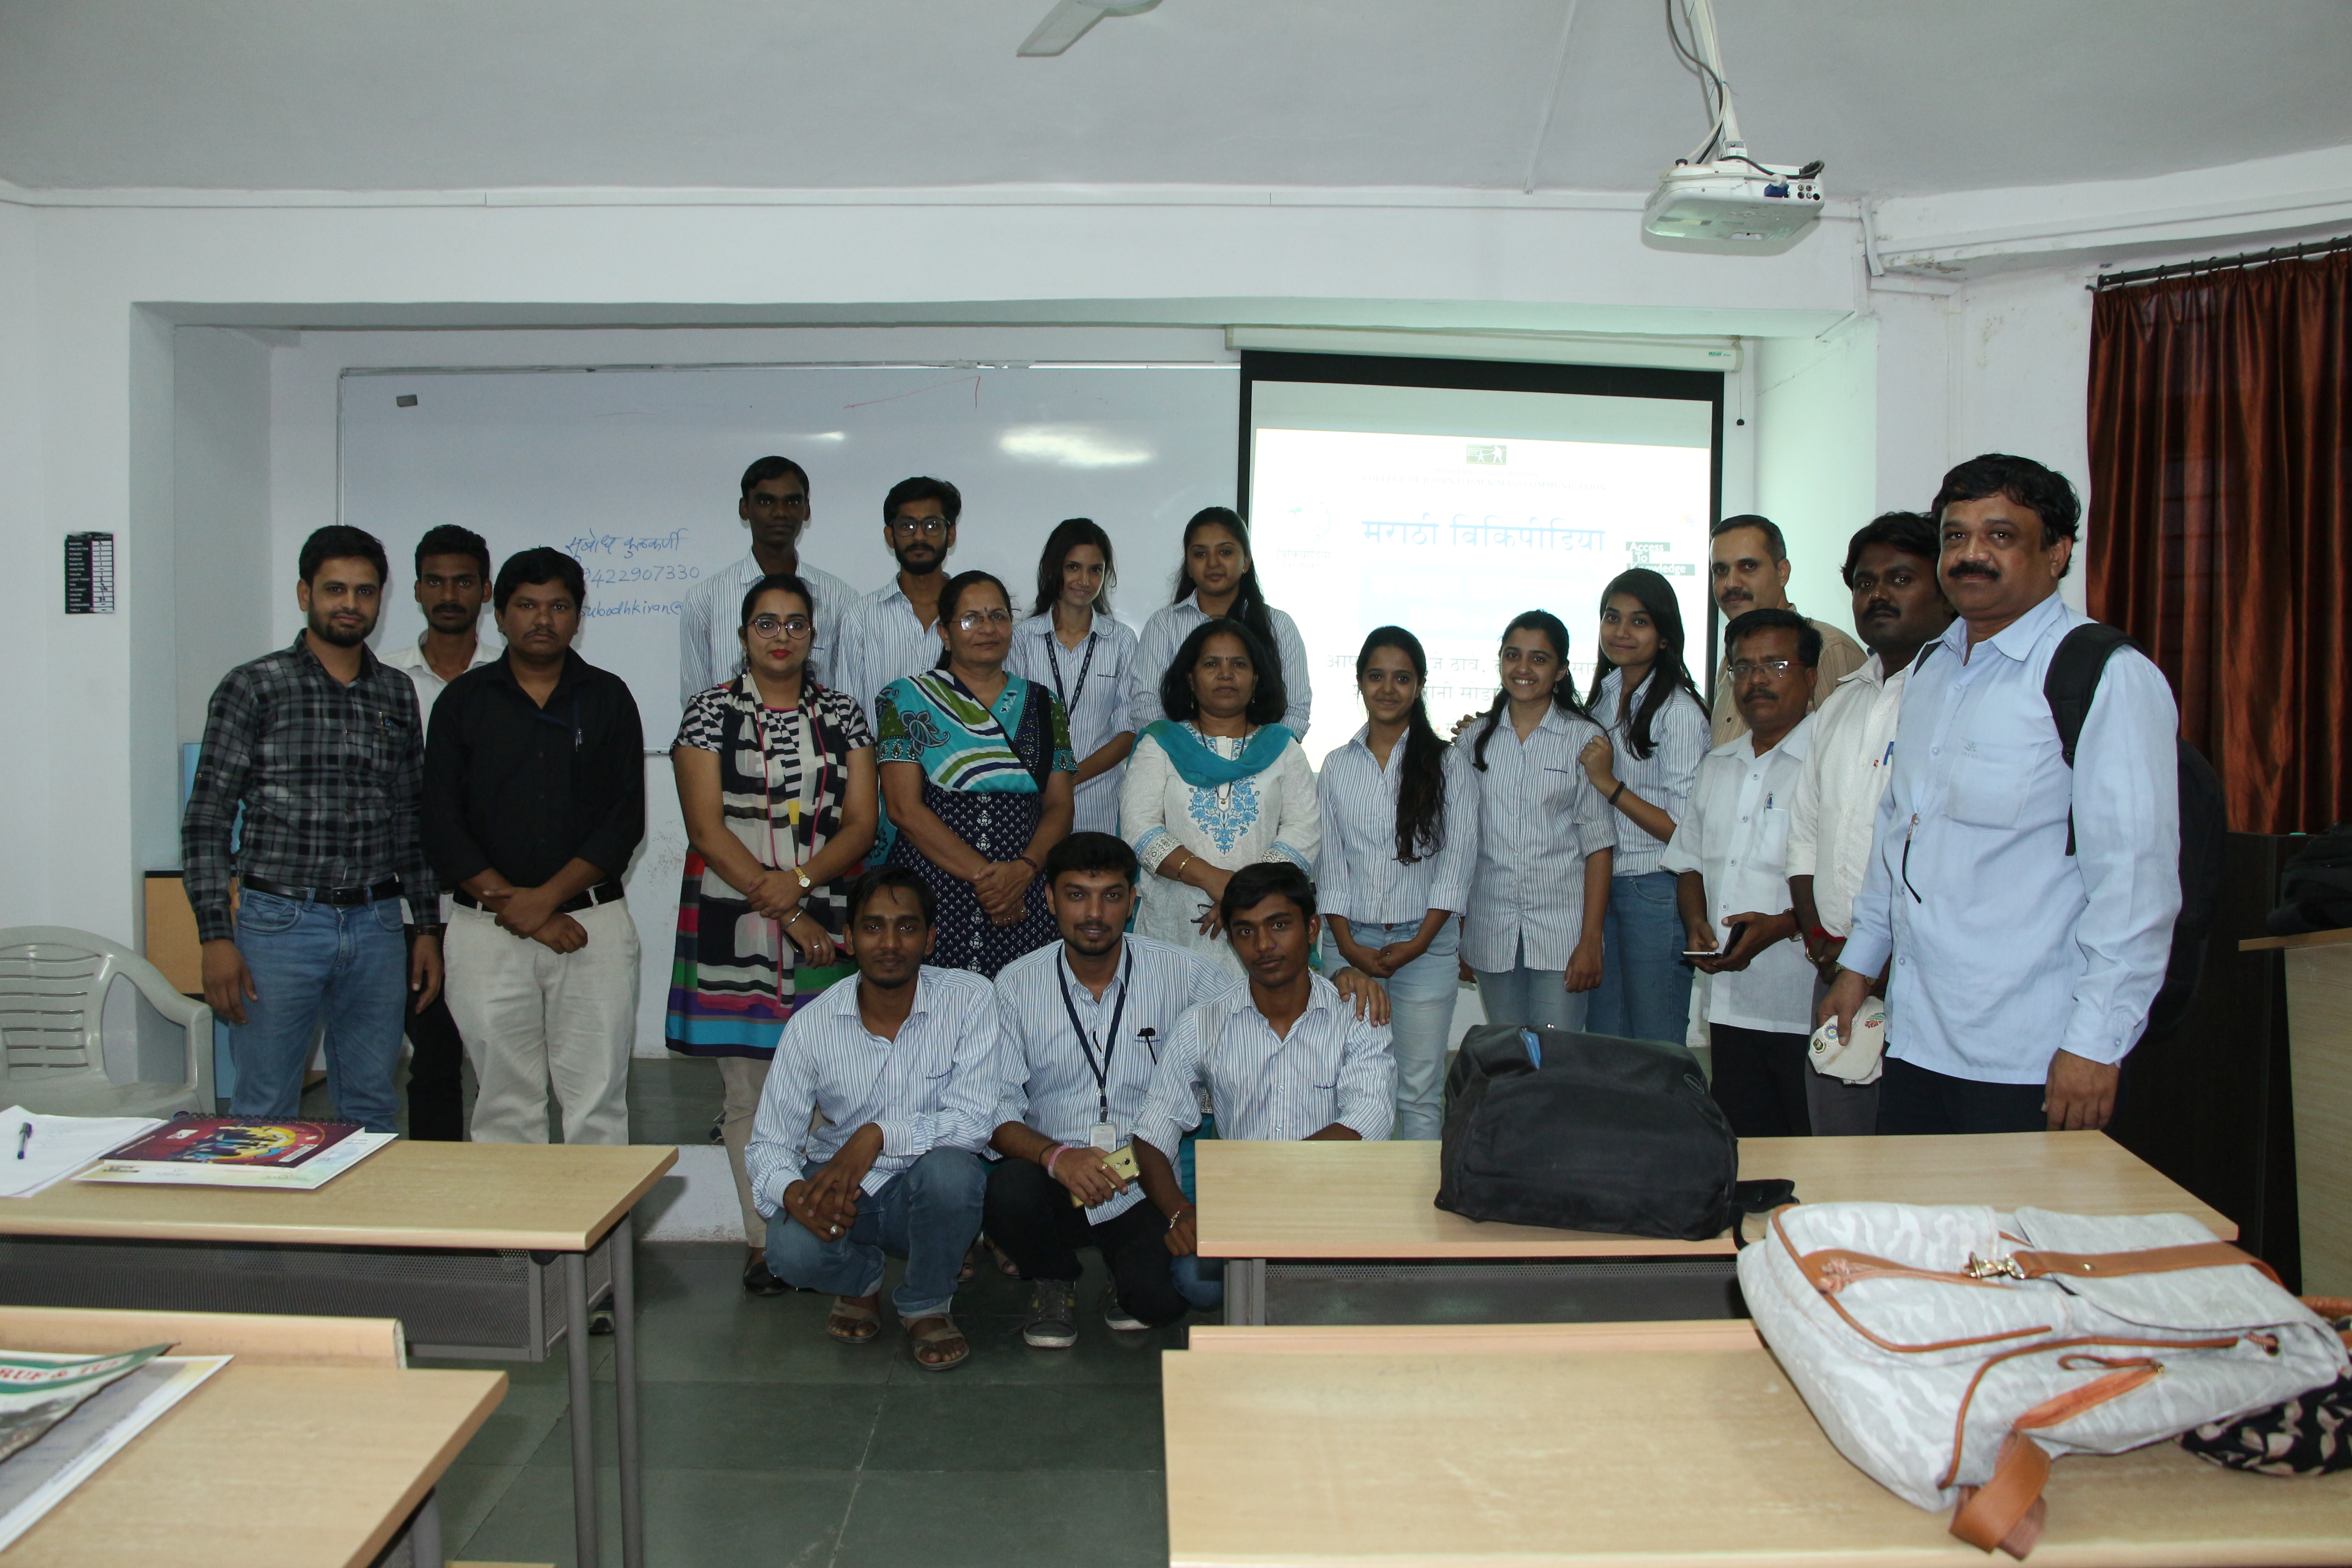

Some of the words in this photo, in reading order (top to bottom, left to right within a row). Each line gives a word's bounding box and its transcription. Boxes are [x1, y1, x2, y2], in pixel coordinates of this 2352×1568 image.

[1423, 476, 1484, 486] JOURNALISM
[1486, 479, 1494, 487] &
[1497, 479, 1522, 488] MASS
[1524, 480, 1606, 491] COMMUNICATION
[1361, 511, 1440, 546] मराठी
[1448, 513, 1606, 552] विकिपीडिया
[1629, 542, 1664, 552] Access
[1635, 552, 1648, 562] To
[1371, 565, 1462, 602] संपादन
